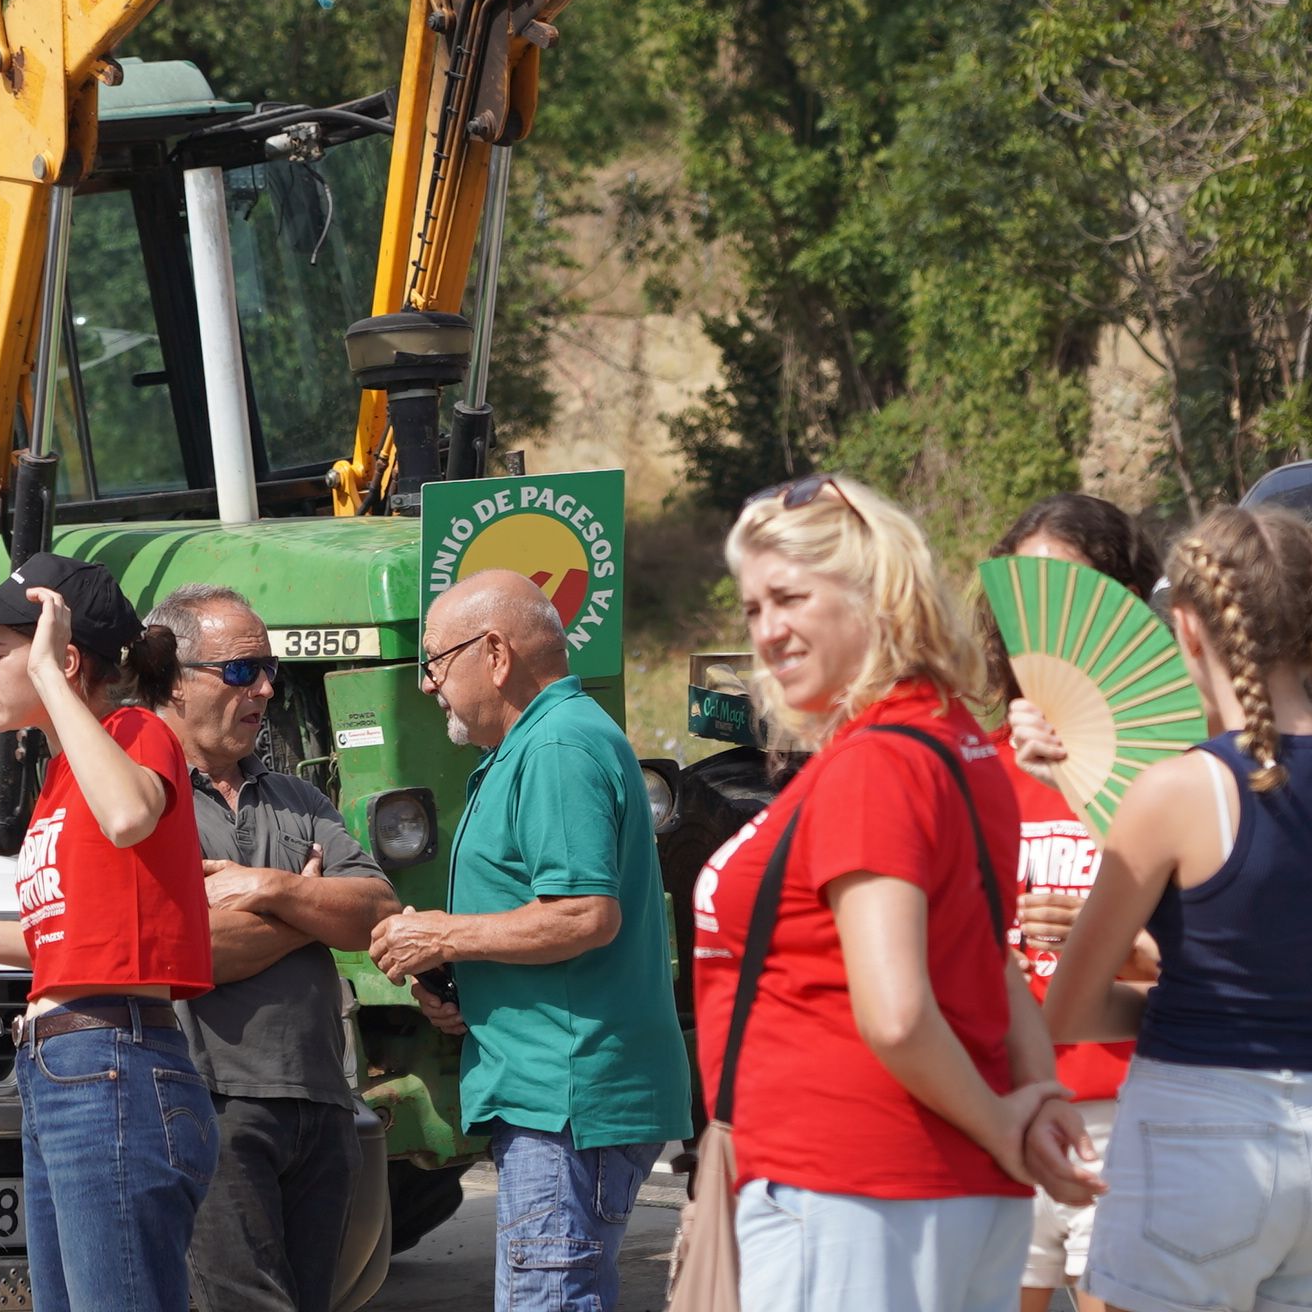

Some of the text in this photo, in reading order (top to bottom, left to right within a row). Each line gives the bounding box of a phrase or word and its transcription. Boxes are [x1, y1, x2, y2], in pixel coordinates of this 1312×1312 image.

[429, 486, 615, 593] UNIÓ DE PAGESOS
[285, 630, 360, 656] 3350
[567, 588, 615, 652] NYA
